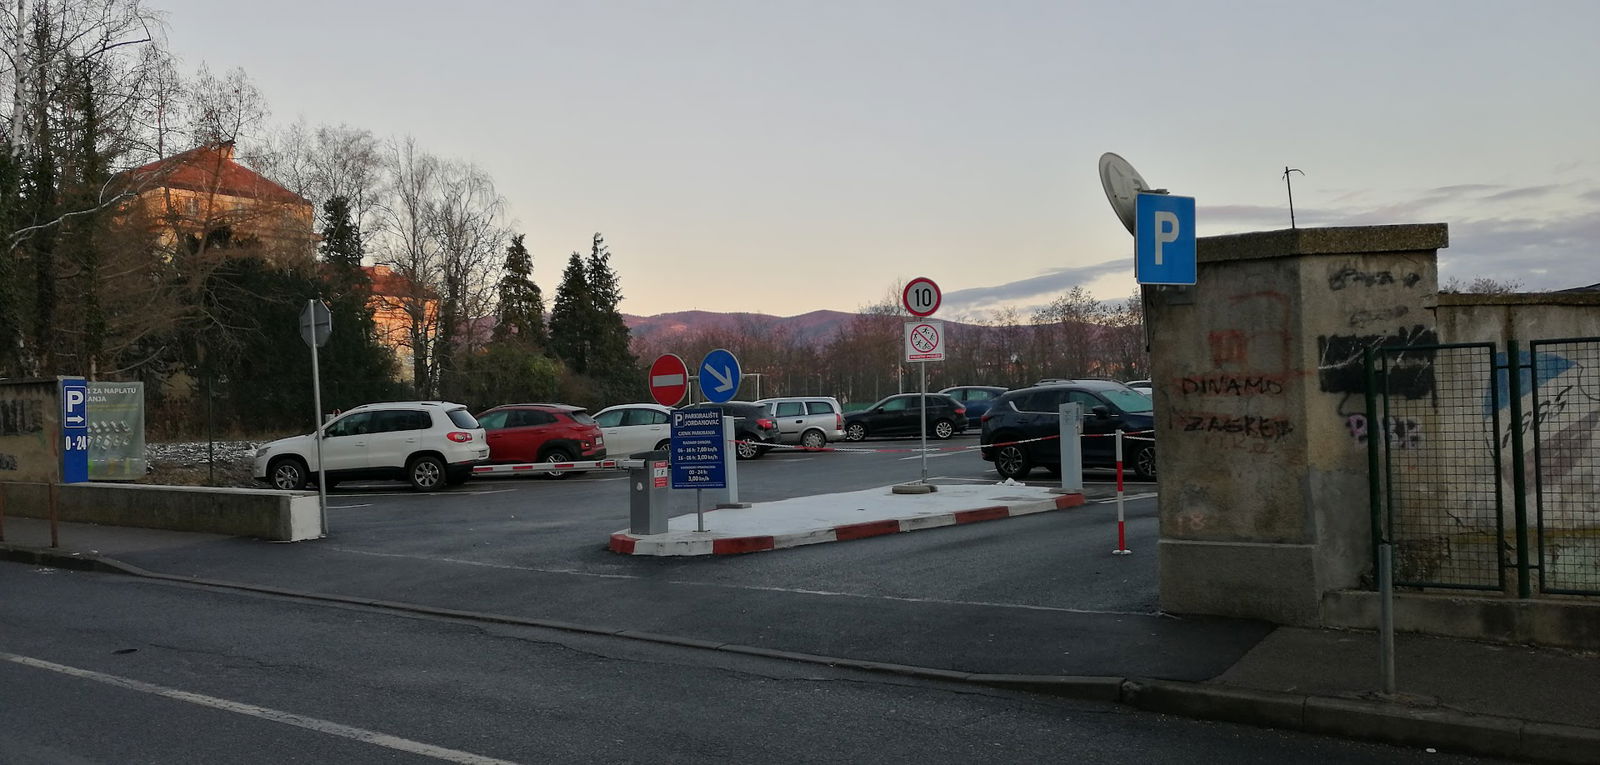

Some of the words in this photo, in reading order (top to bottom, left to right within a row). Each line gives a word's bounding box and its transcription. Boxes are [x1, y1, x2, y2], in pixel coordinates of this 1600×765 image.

[1155, 211, 1180, 265] P
[915, 288, 931, 307] 10
[1181, 376, 1283, 396] DINAMO
[67, 390, 84, 413] P
[675, 414, 683, 426] P
[684, 419, 720, 427] JORDANOVAC
